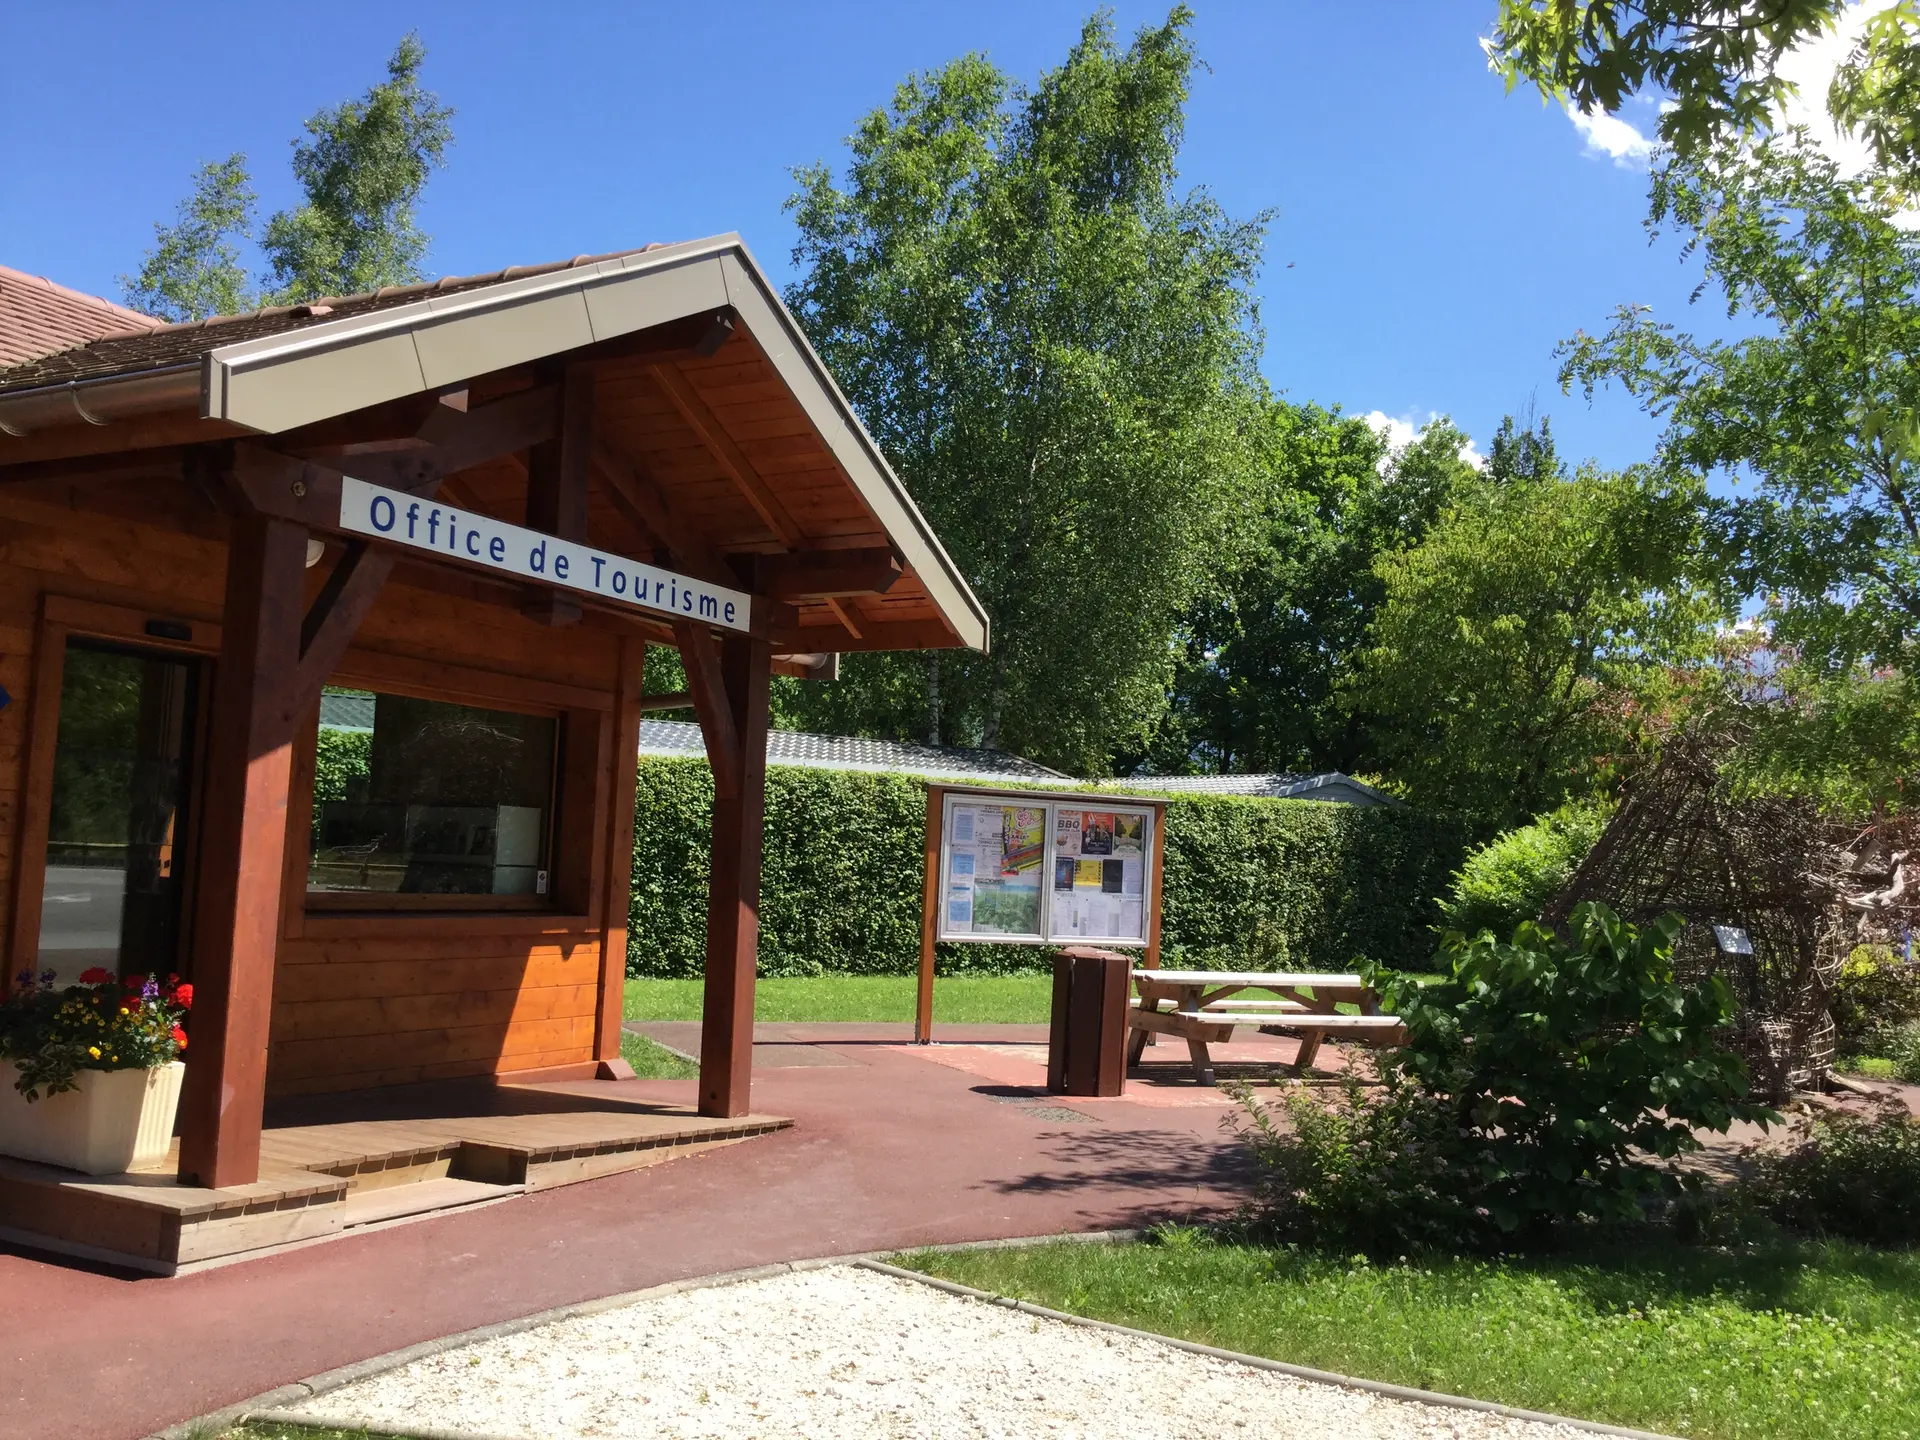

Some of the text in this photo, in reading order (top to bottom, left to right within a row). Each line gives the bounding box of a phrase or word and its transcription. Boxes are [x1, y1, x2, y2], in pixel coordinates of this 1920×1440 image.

[370, 495, 737, 624] Office de Tourisme
[1058, 820, 1080, 829] BBQ
